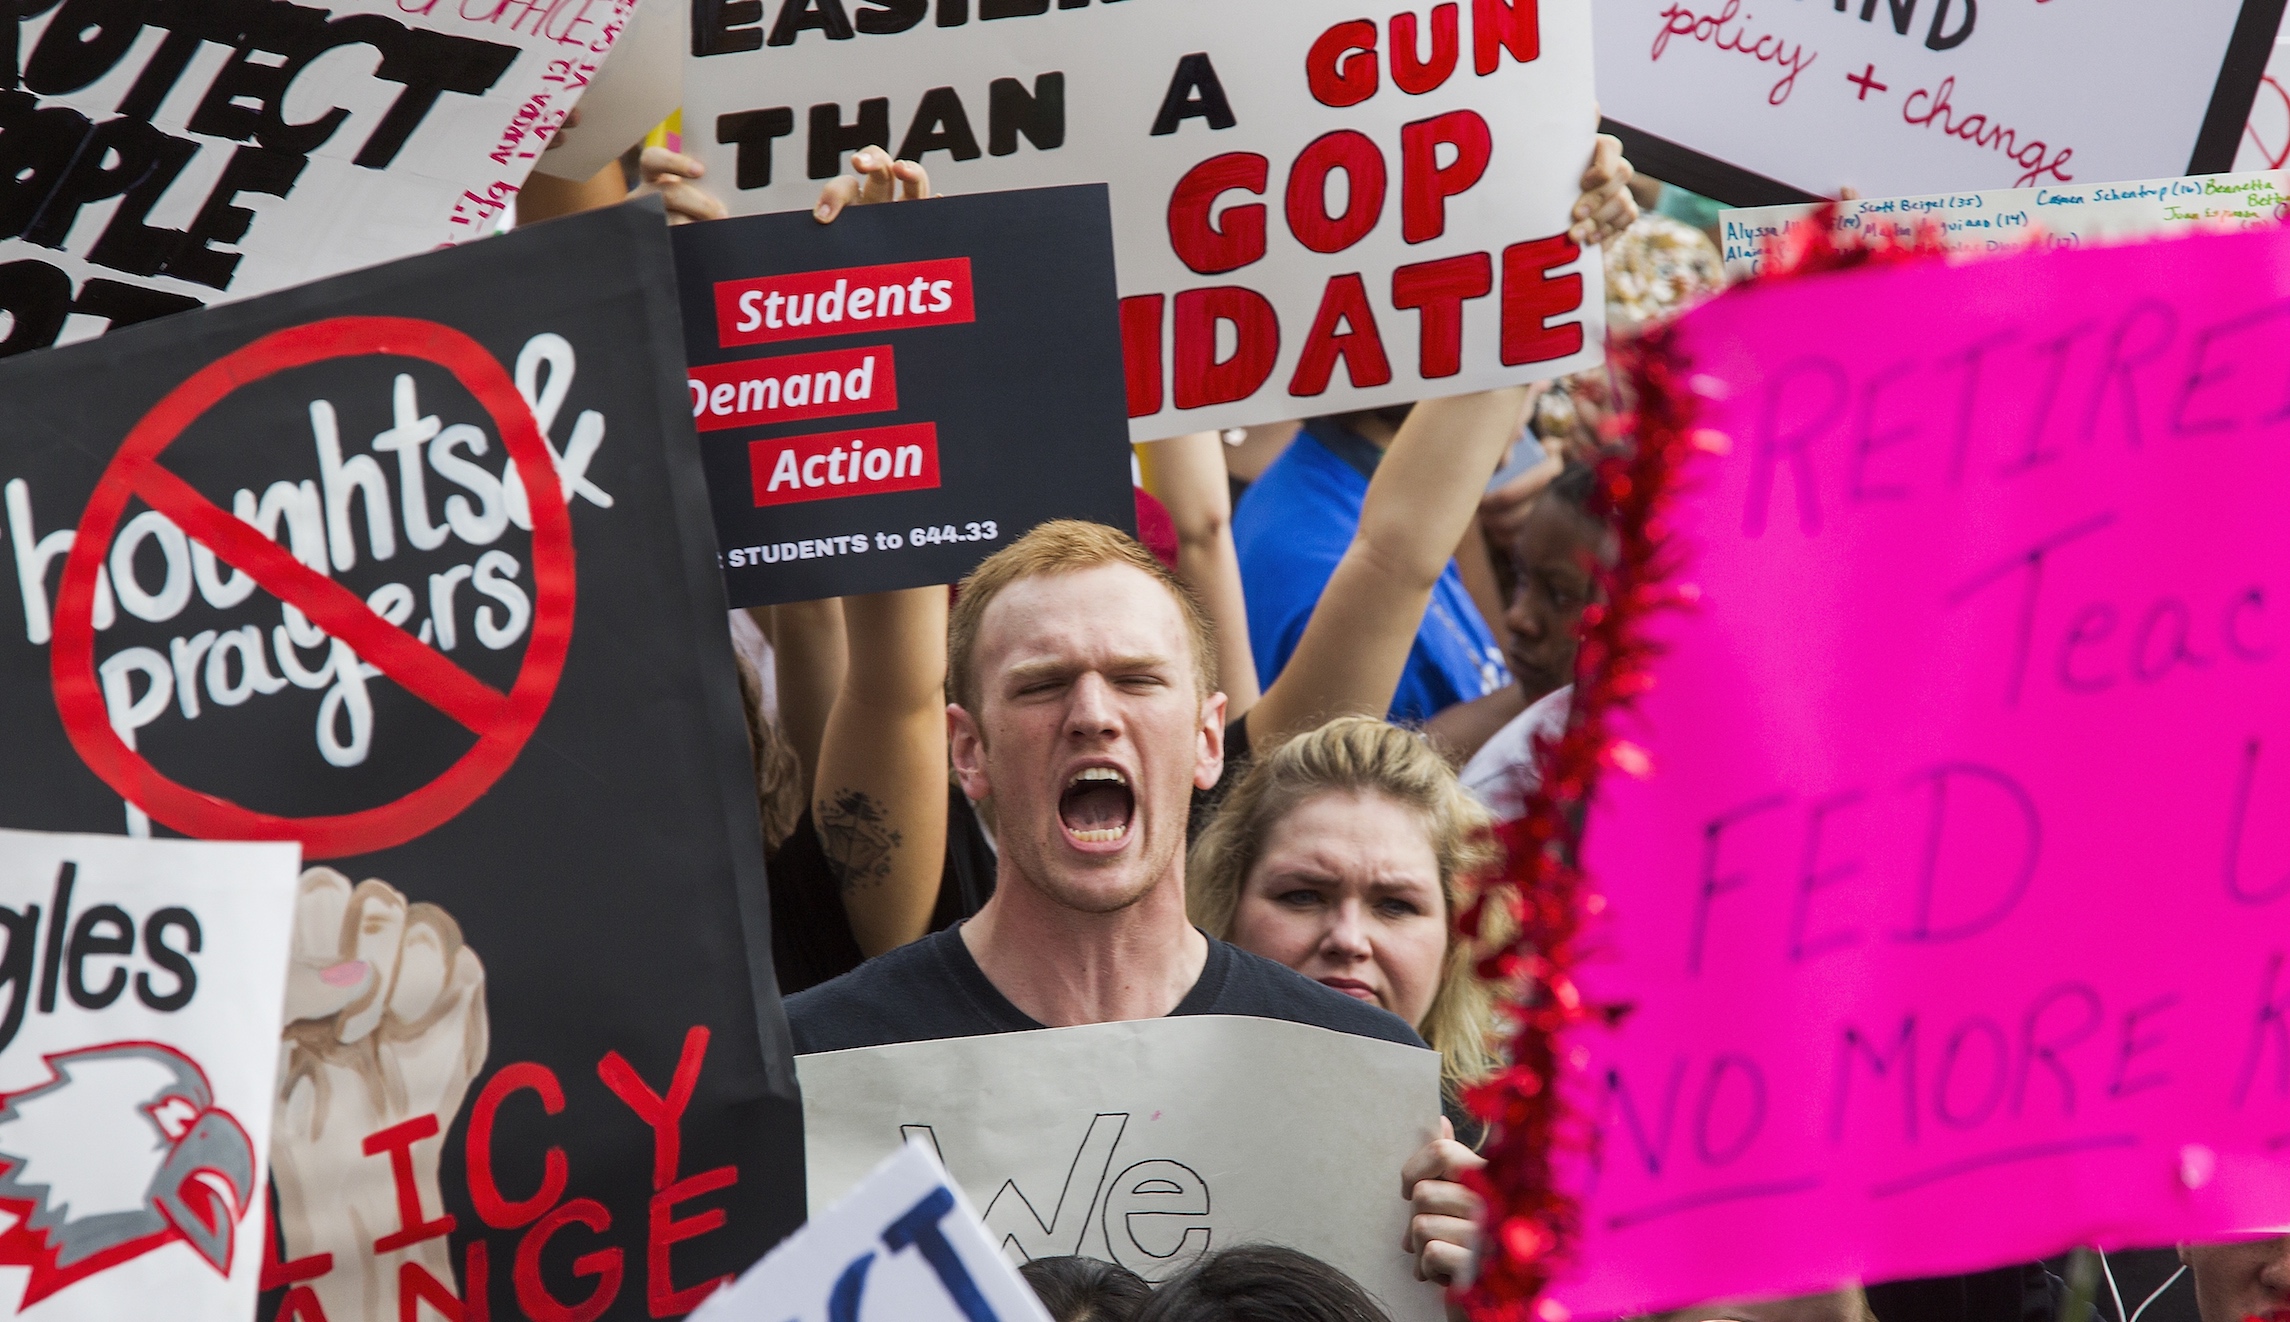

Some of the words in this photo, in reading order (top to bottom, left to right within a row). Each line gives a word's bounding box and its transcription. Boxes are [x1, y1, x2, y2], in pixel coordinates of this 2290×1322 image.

[0, 0, 523, 170] OTECT
[716, 71, 1065, 190] THAN
[1149, 52, 1237, 136] A
[1306, 0, 1540, 107] GUN
[1651, 0, 1818, 105] policy
[1903, 75, 2074, 188] change
[0, 96, 309, 291] OPLE
[1167, 109, 1492, 276] GOP
[736, 275, 953, 333] Students
[766, 440, 923, 492] Action
[1740, 297, 2290, 540] RETIRE
[728, 534, 869, 568] STUDENTS
[875, 529, 904, 550] to
[909, 519, 998, 547] 644.33
[1686, 761, 2043, 977] FED
[1585, 1052, 1768, 1195] NO
[1829, 980, 2183, 1144] MORE
[275, 1165, 740, 1322] NGE
[900, 1112, 1211, 1284] We
